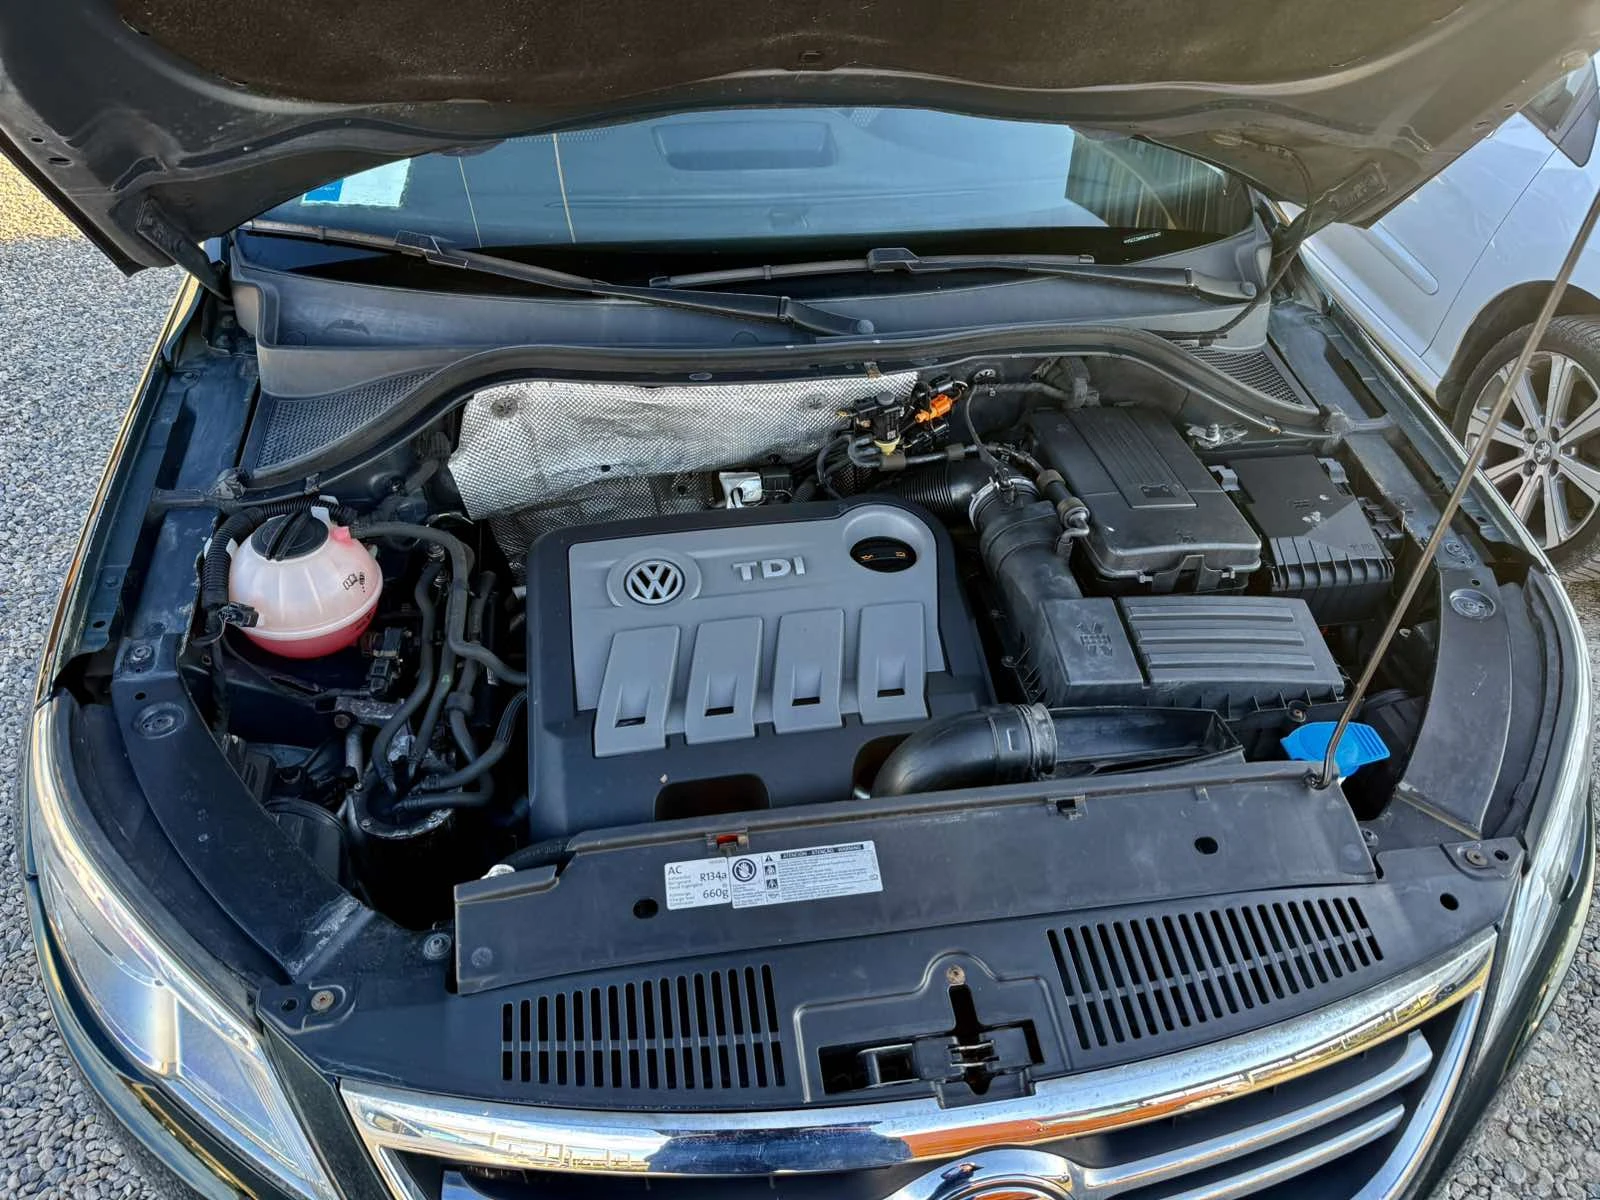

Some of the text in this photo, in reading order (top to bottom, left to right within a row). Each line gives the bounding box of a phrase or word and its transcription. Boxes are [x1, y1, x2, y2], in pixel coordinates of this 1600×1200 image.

[732, 556, 807, 581] TDI
[668, 865, 683, 875] AC
[700, 871, 728, 881] R134a
[703, 888, 730, 899] 660g
